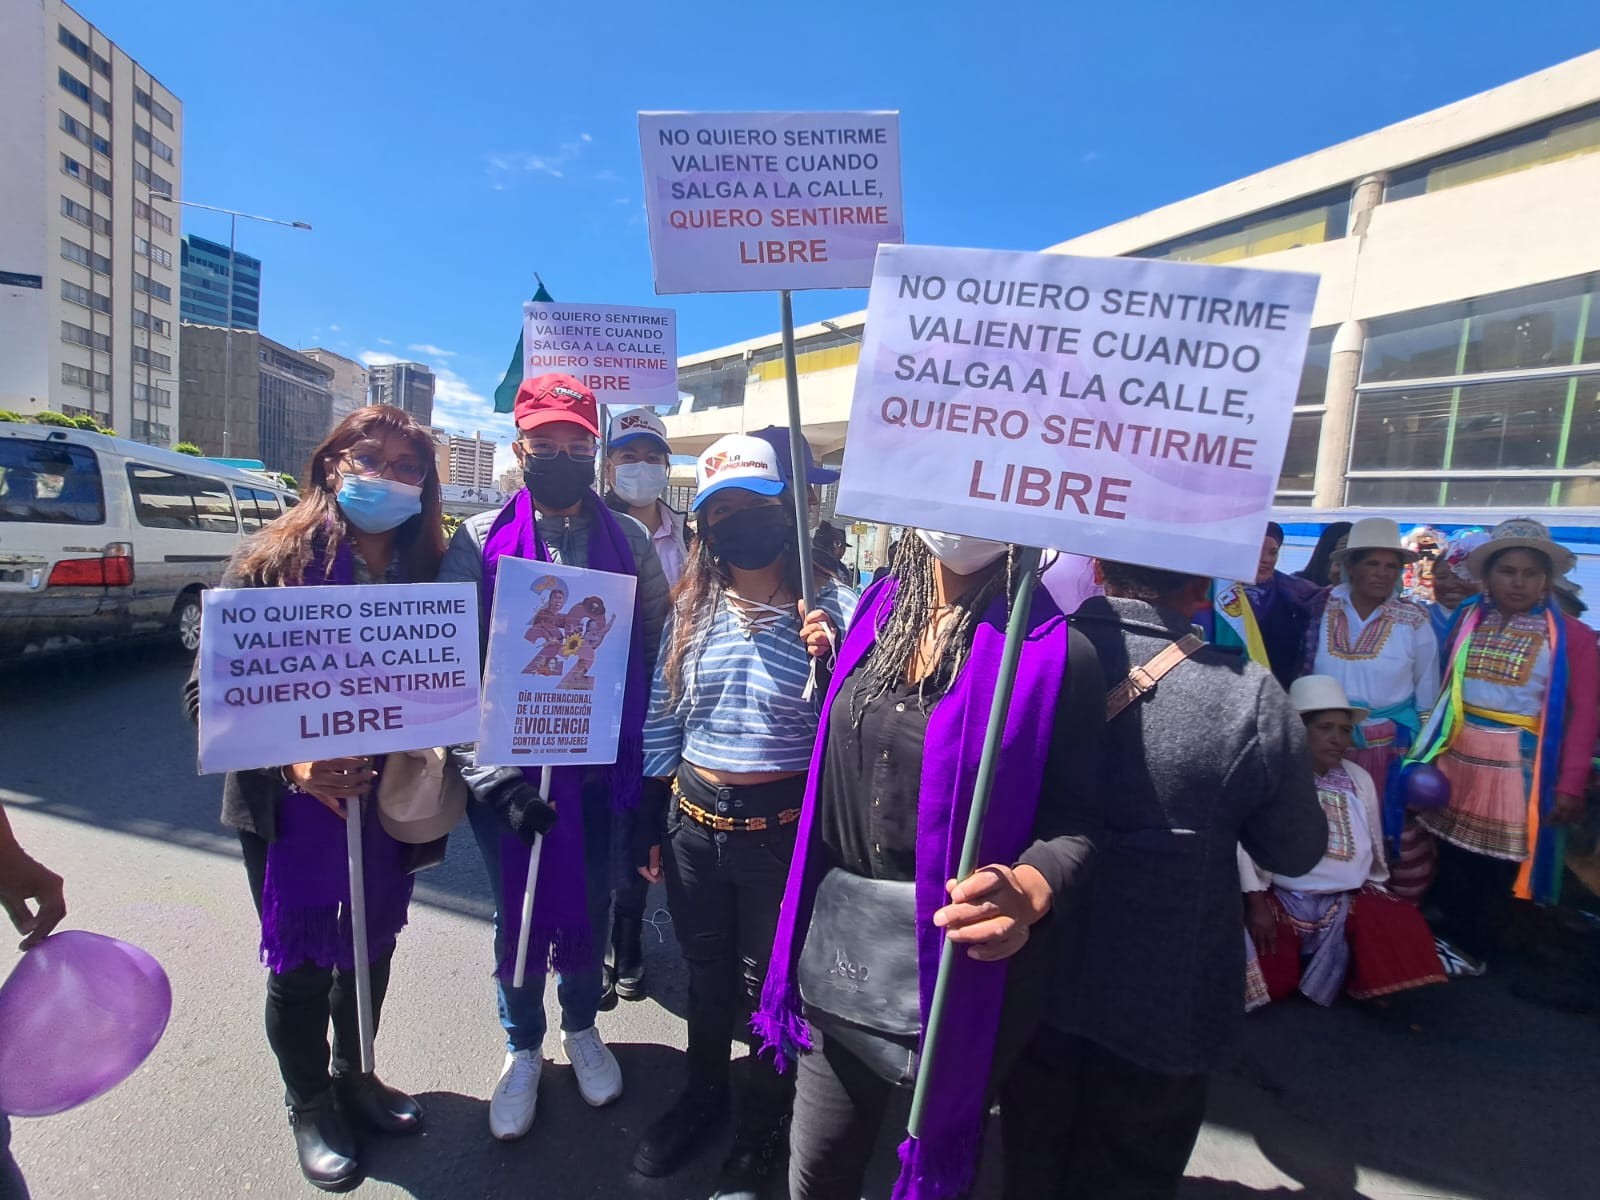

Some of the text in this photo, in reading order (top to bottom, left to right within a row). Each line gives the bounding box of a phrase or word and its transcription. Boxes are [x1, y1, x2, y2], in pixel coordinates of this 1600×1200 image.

[659, 128, 886, 146] NO QUIERO SENTIRME
[672, 153, 878, 172] VALIENTE CUANDO
[671, 180, 883, 199] SALGA A LA CALLE,
[670, 206, 889, 229] QUIERO SENTIRME
[740, 240, 828, 264] LIBRE
[899, 274, 1290, 331] NO QUIERO SENTIRME
[530, 312, 669, 326] NO QUIERO SENTIRME
[536, 325, 663, 339] VALIENTE CUANDO
[533, 340, 665, 355] SALGA A LA CALLE,
[909, 314, 1260, 373] VALIENTE CUANDO
[531, 355, 668, 370] QUIERO SENTIRME
[571, 375, 630, 390] IBRE
[895, 355, 1255, 424] SALGA A LA CALLE,
[881, 397, 1257, 469] QUIERO SENTIRME
[969, 460, 1132, 520] LIBRE
[222, 599, 466, 624] NO QUIERO SENTIRME
[233, 623, 457, 650] VALIENTE CUANDO
[230, 647, 461, 677] SALGA A LA CALLE,
[224, 670, 466, 707] QUIERO SENTIRME
[519, 690, 592, 704] DÍA INTERNACIONAL
[517, 703, 592, 716] DE LA ELIMINACIÓN
[300, 706, 404, 739] LIBRE
[514, 726, 522, 734] LA
[515, 717, 524, 725] DE
[524, 717, 590, 734] VIOLENCIA
[512, 737, 589, 745] CONTRA LAS MUJERES
